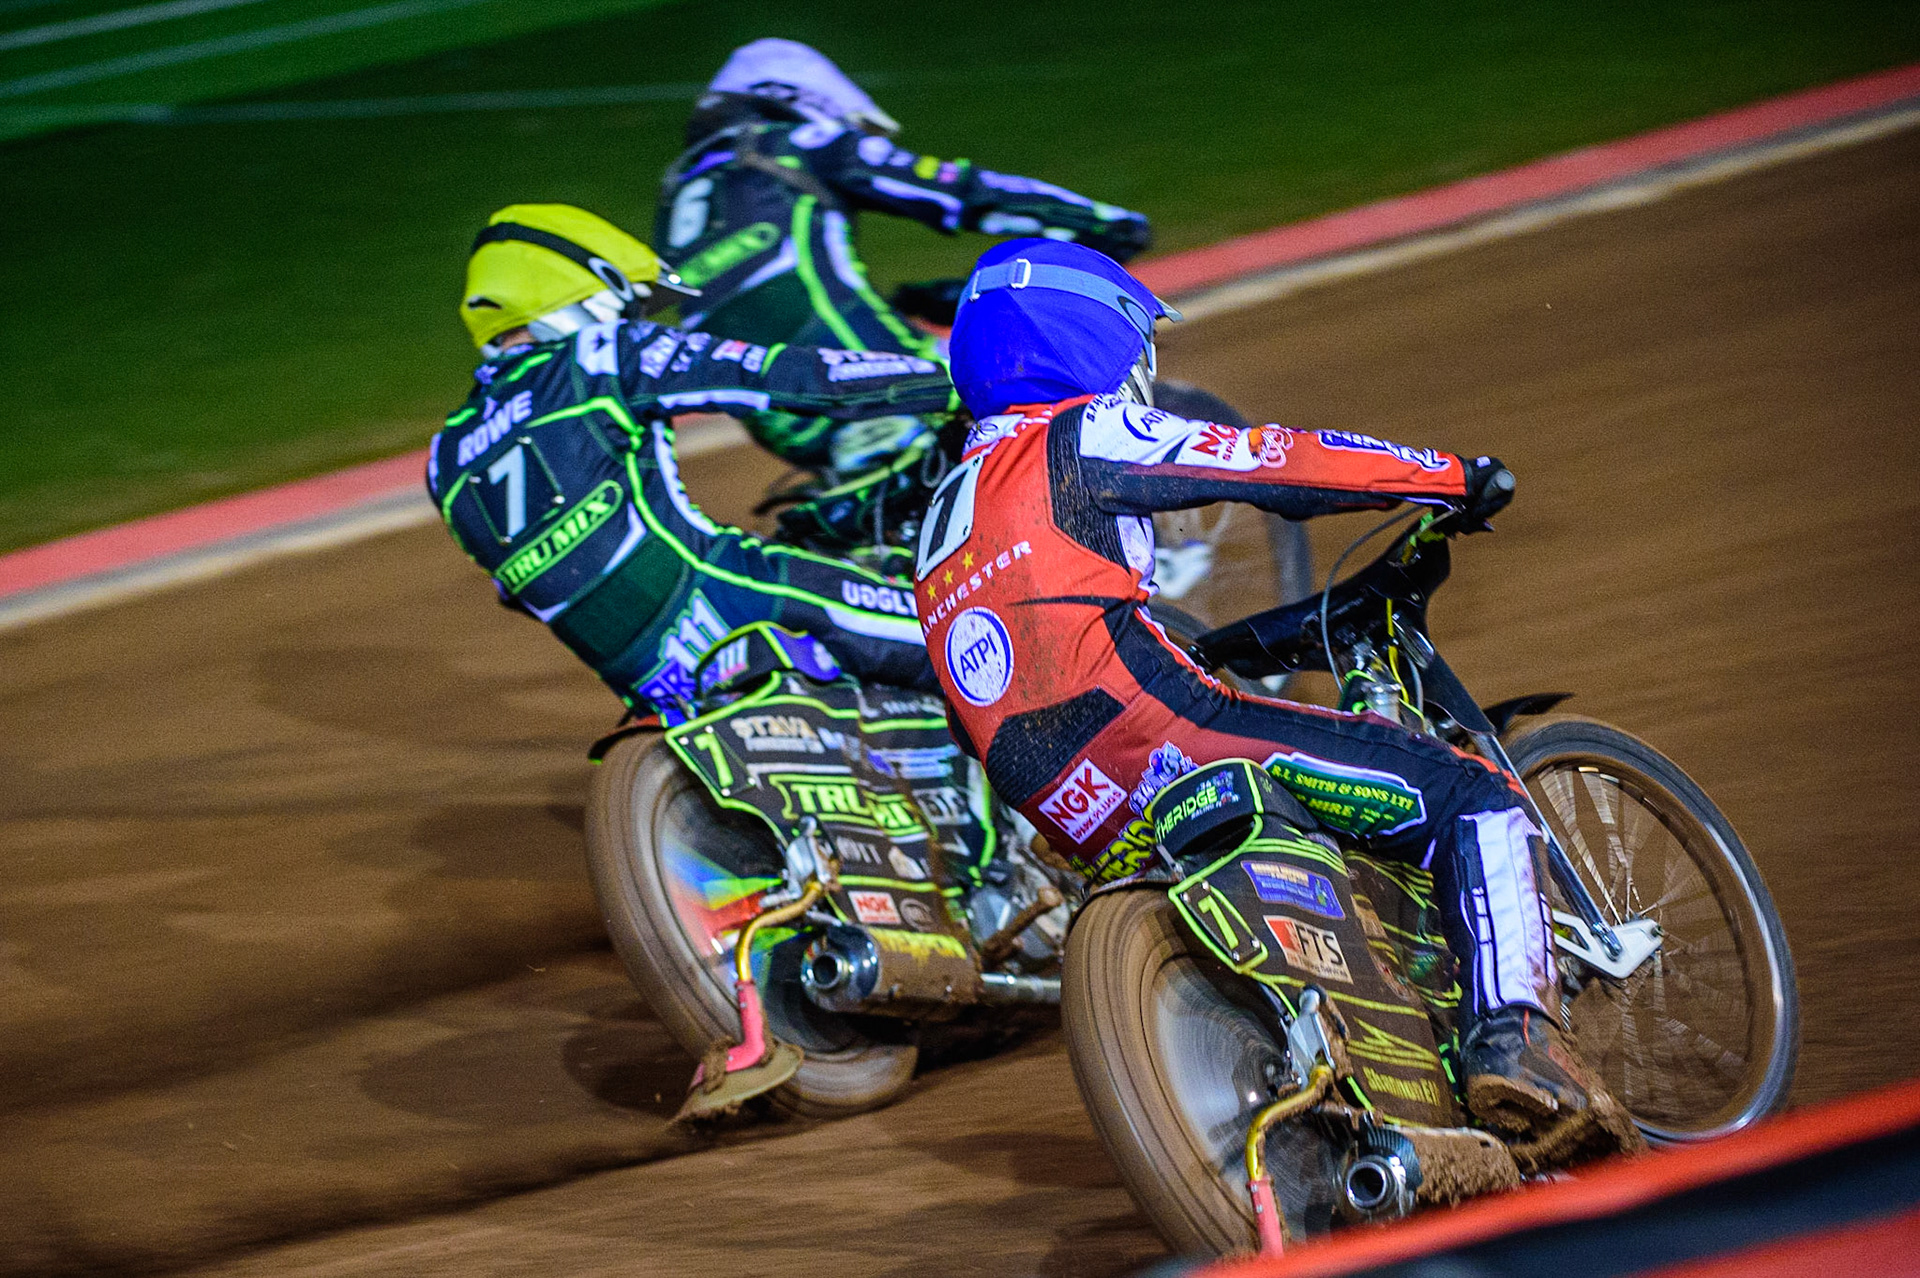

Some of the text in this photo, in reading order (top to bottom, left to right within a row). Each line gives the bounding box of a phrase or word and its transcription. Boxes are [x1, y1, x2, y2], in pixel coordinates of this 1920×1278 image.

[458, 390, 533, 466] ROWE
[922, 540, 1033, 637] ANCHESTER
[958, 631, 998, 681] ATPI
[1045, 767, 1110, 831] NGK
[1294, 773, 1338, 794] SMITH
[1338, 783, 1352, 795] &
[1353, 785, 1390, 803] SONS
[1295, 924, 1344, 966] FTS
